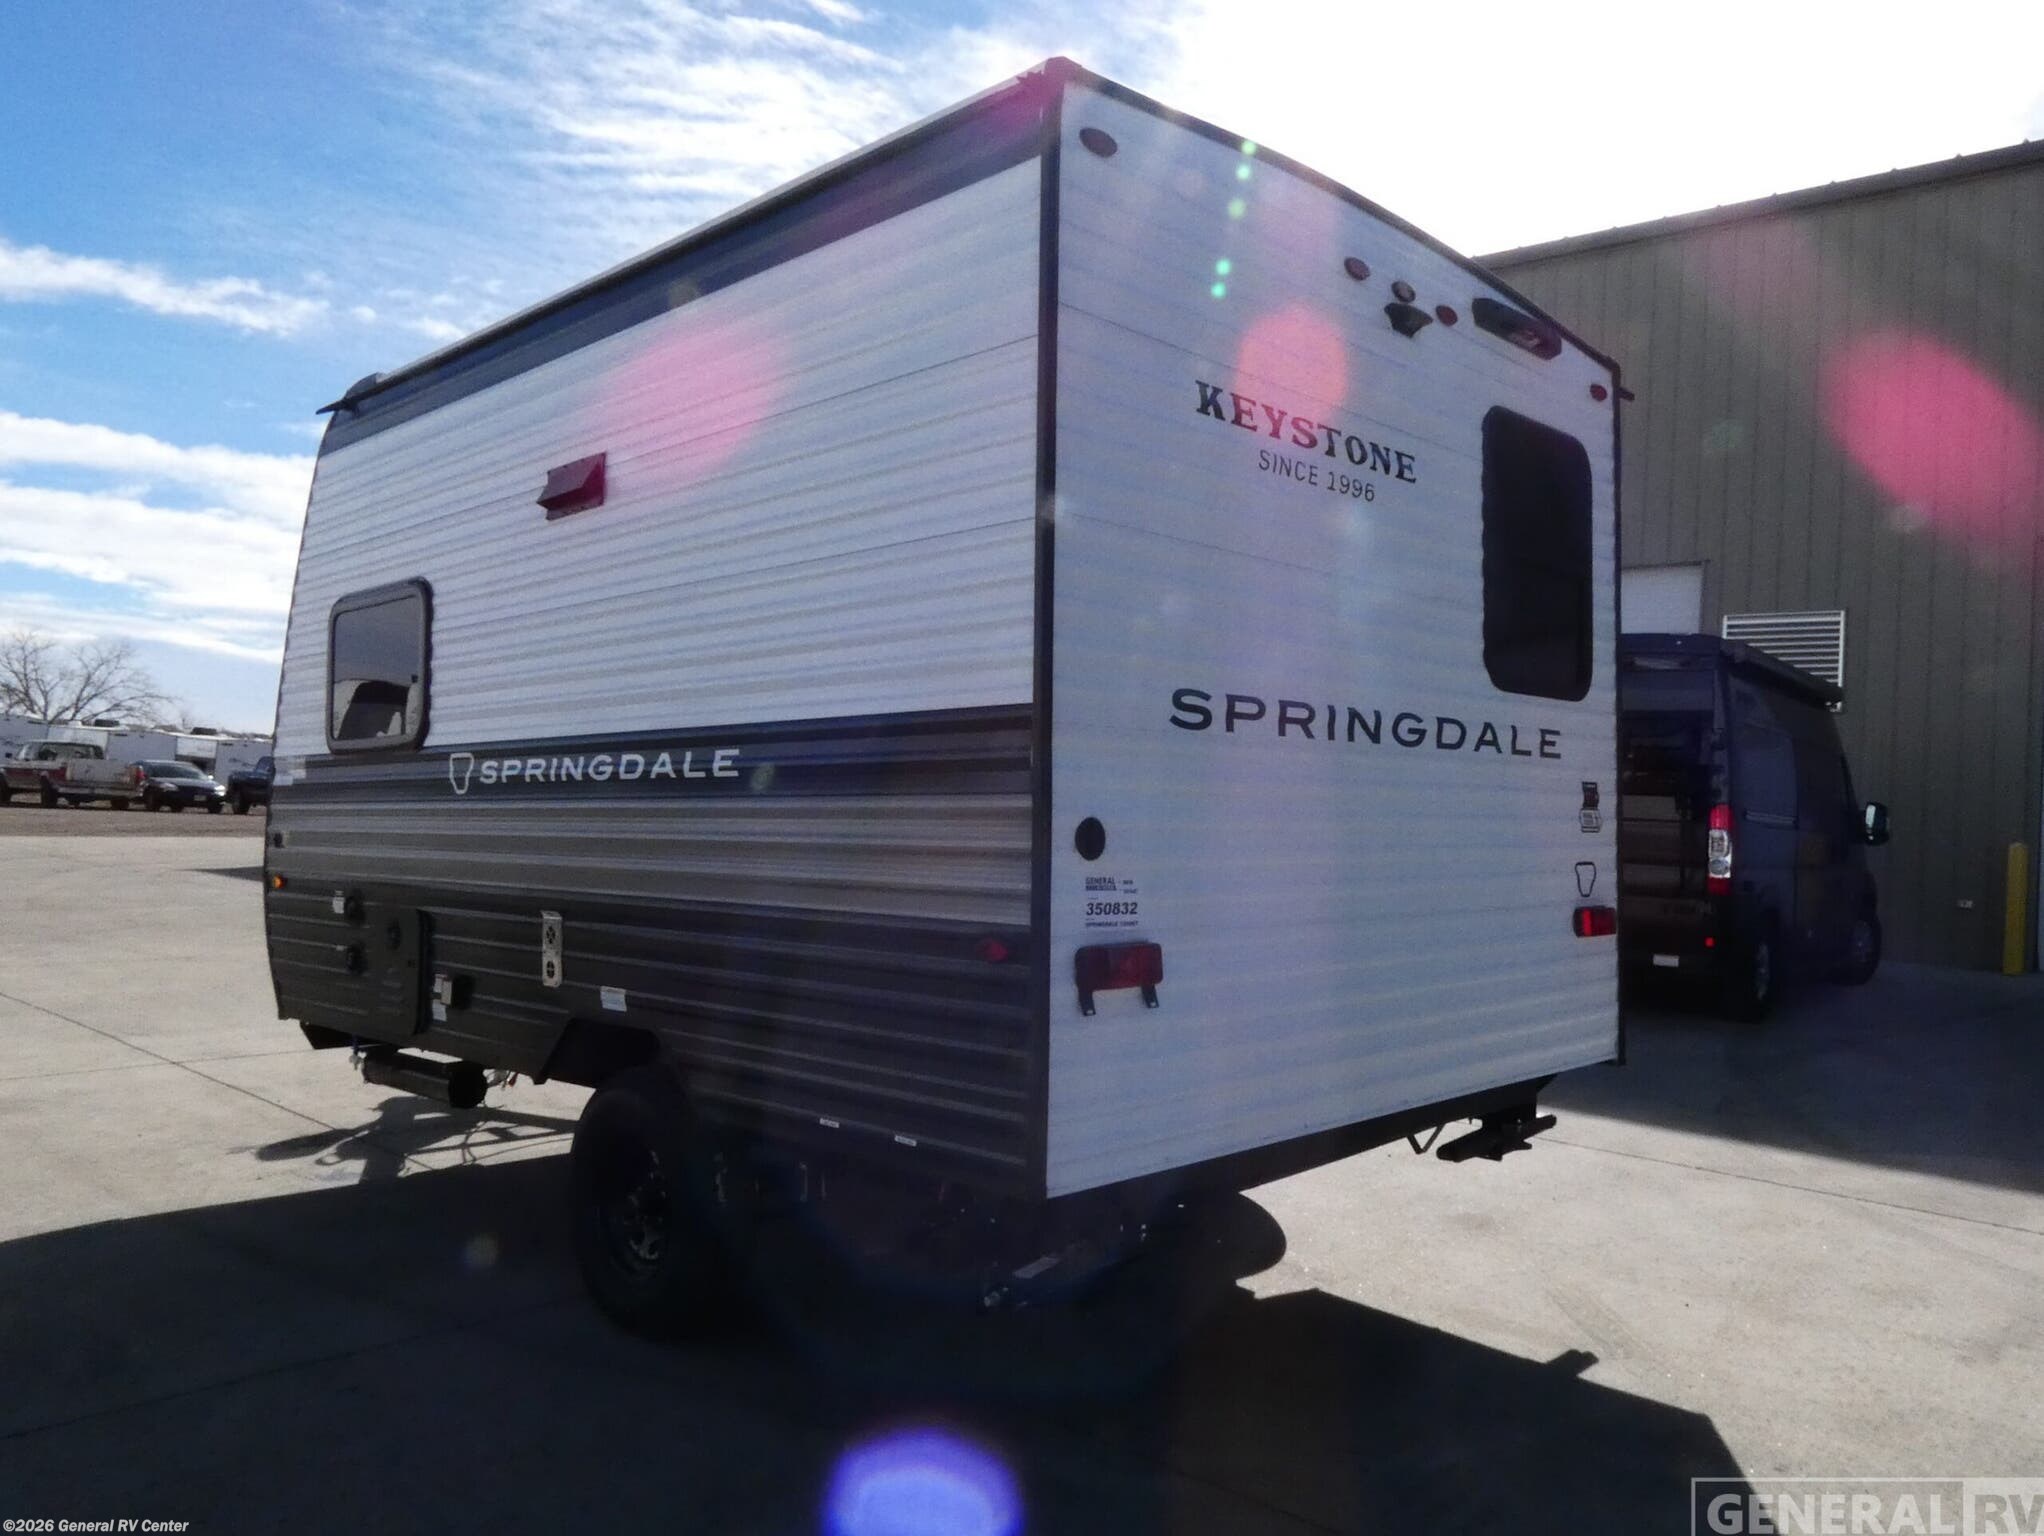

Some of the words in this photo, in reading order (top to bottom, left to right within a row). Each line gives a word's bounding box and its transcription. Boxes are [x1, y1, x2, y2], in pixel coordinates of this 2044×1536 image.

[1195, 380, 1418, 484] KEYSTONE
[1258, 449, 1318, 486] SINCE
[1327, 471, 1375, 502] 1996
[1169, 687, 1562, 760] SPRINGDALE
[479, 749, 740, 785] SPRINGDALE
[1086, 902, 1138, 916] 350832
